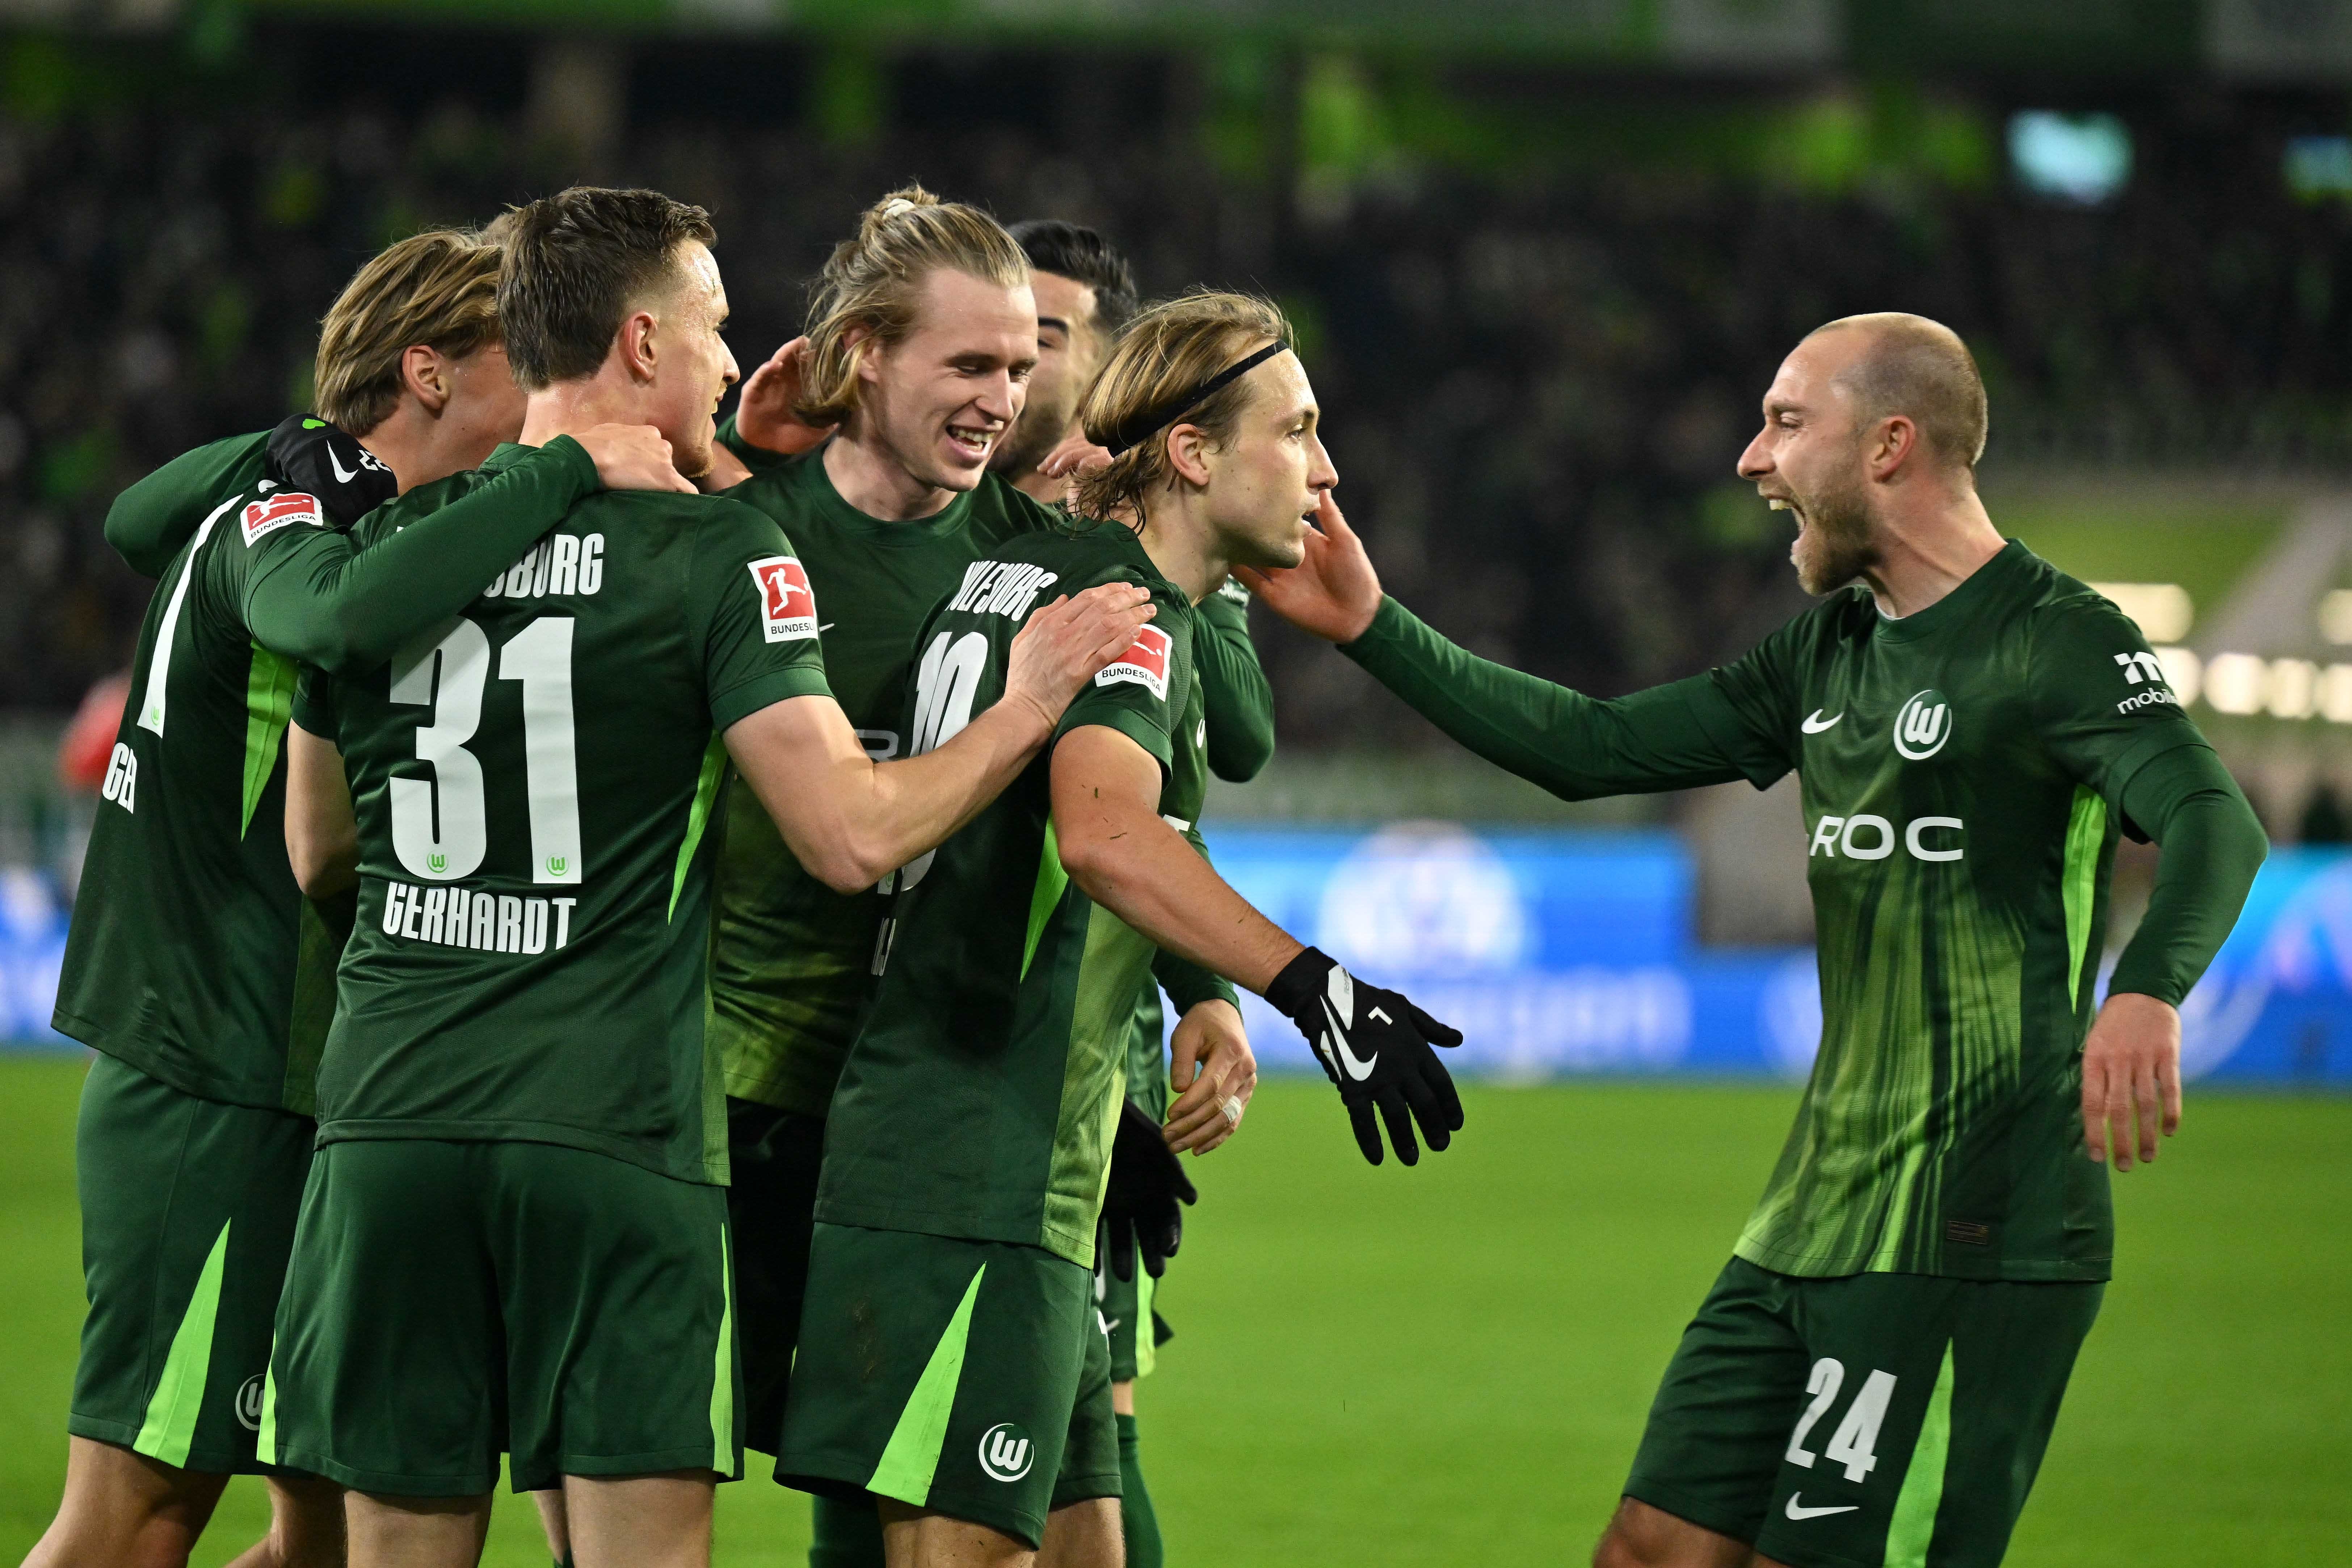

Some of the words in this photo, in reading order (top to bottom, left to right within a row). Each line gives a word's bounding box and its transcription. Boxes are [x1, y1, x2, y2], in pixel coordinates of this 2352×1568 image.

[251, 514, 316, 539] BUNDESLIGA
[483, 533, 605, 598] BURG
[1102, 667, 1160, 692] BUNDESLIGA
[390, 615, 581, 884] 31
[382, 881, 577, 955] GERHARDT
[1784, 1357, 1898, 1484] 24
